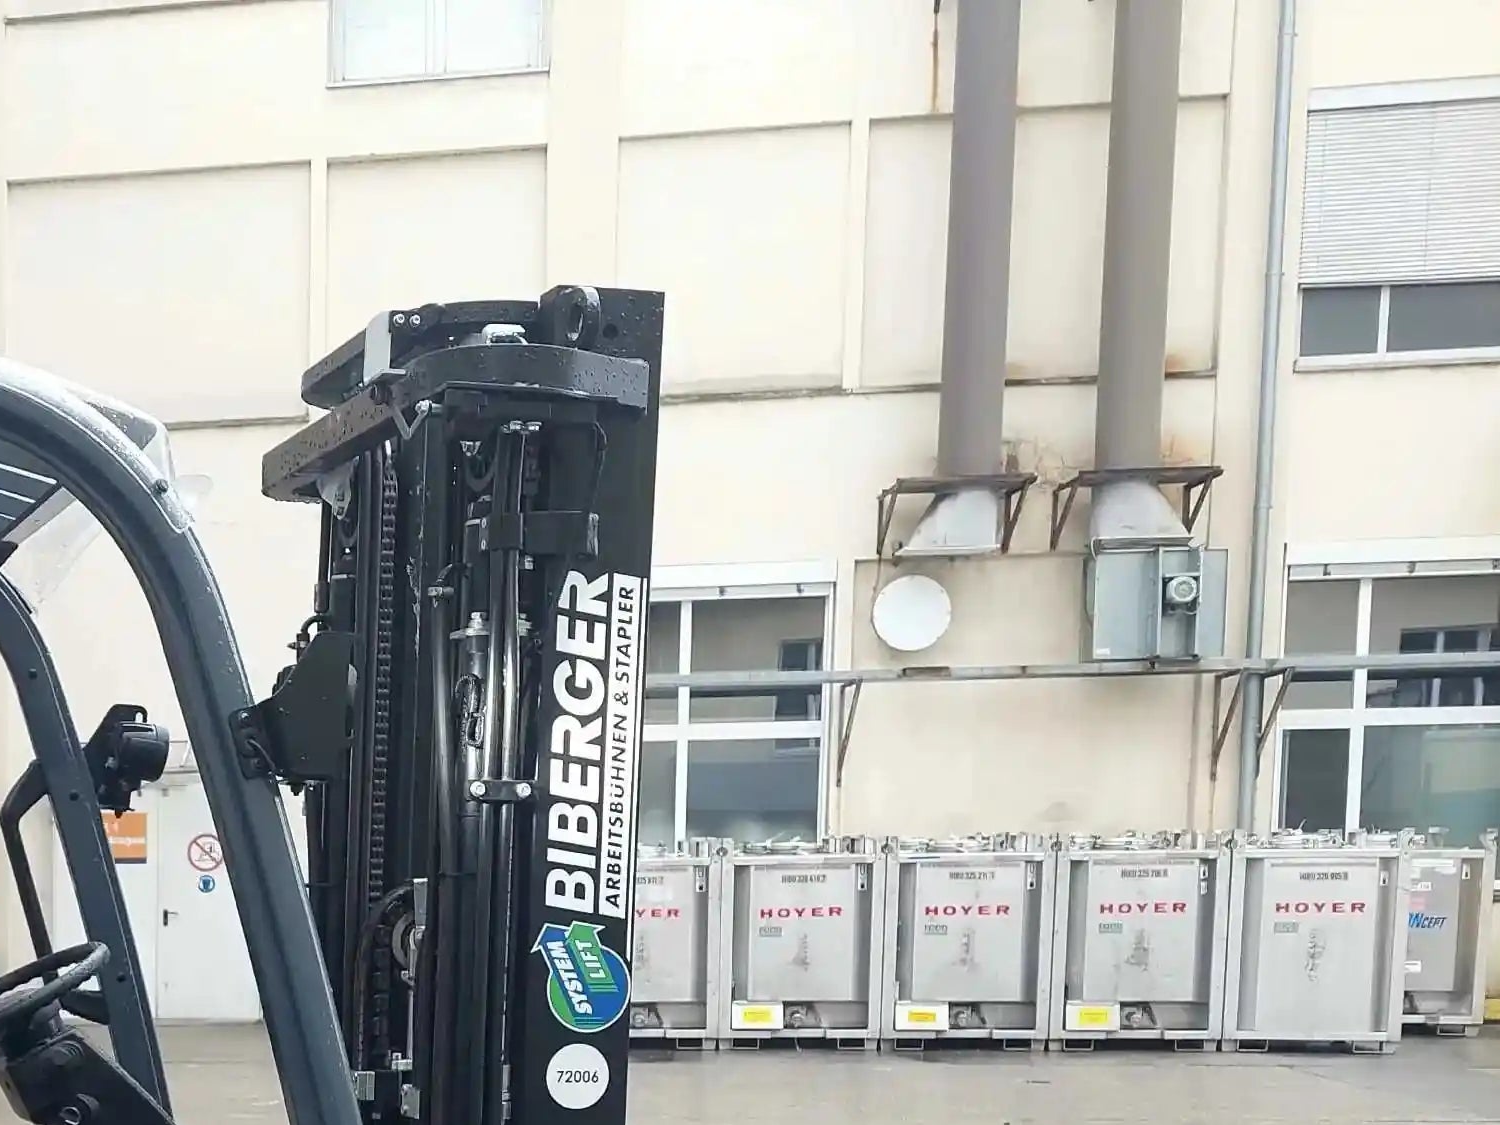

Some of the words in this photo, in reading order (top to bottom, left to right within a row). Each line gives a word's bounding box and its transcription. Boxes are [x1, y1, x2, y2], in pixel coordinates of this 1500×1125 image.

[616, 586, 635, 684] STAPLER
[614, 692, 629, 706] &
[545, 569, 609, 914] BIBERGER
[605, 714, 629, 909] ARBEITSBÜHNEN
[636, 908, 680, 918] YER
[760, 906, 843, 918] HOYER
[925, 904, 1011, 916] HOYER
[1100, 902, 1187, 914] HOYER
[1275, 902, 1366, 913] HOYER
[575, 939, 606, 979] LIFT
[547, 940, 593, 1015] SYSTEM
[556, 1070, 600, 1084] 72006
